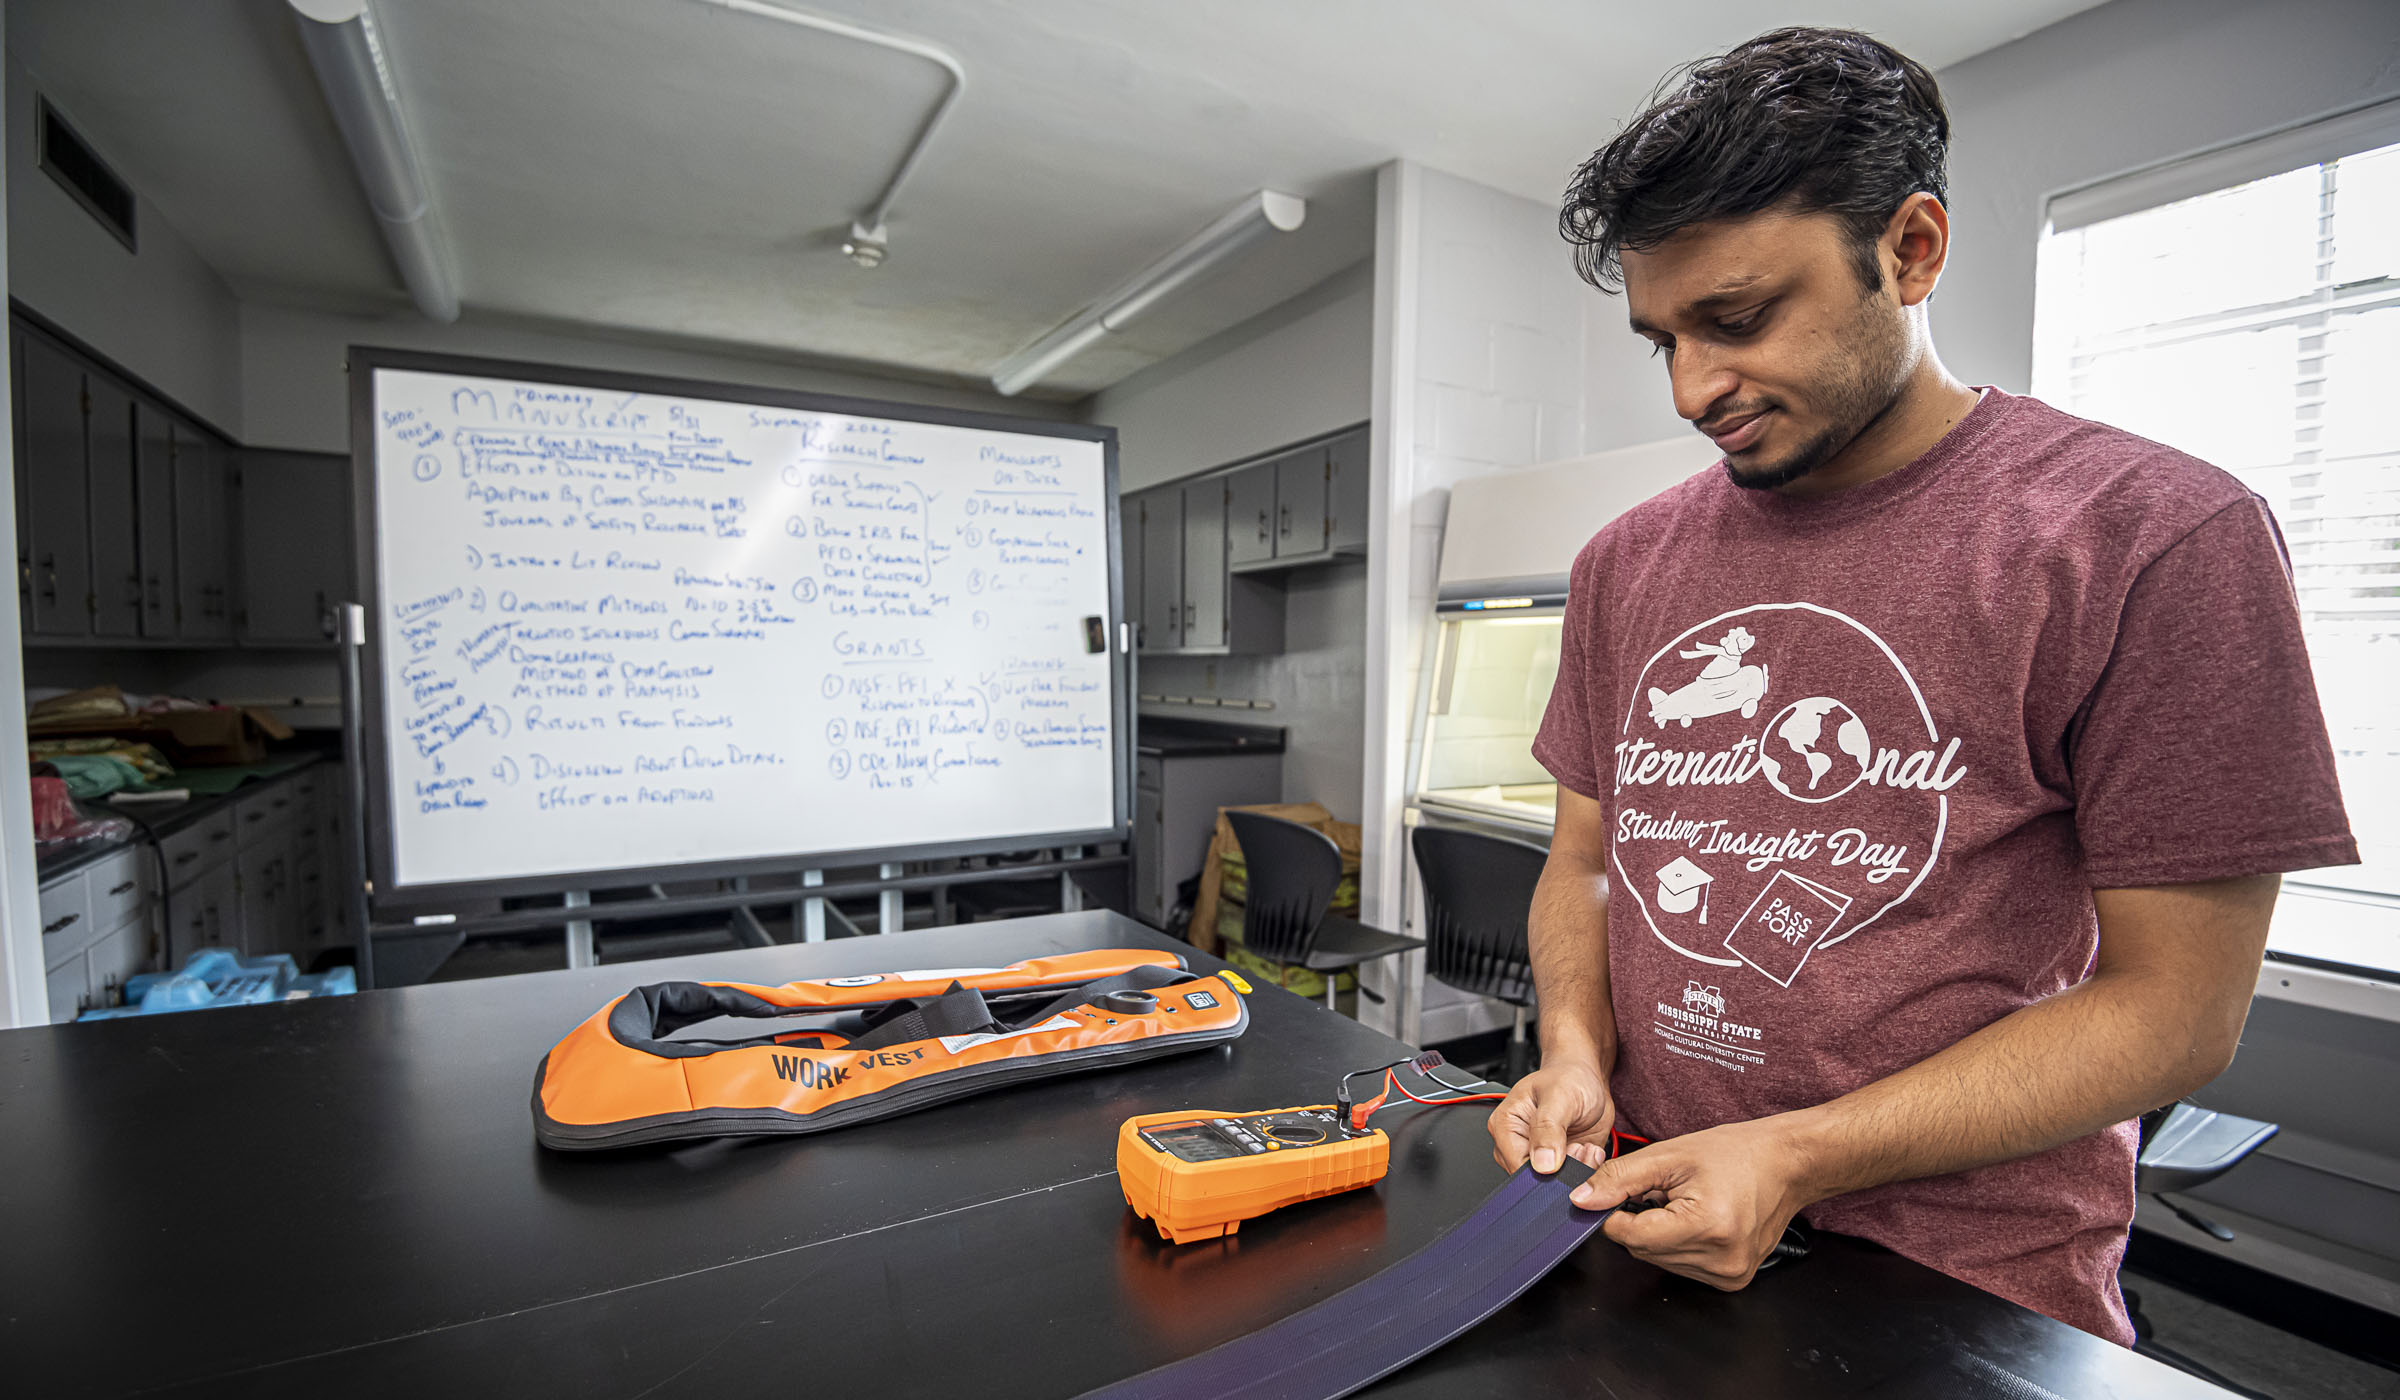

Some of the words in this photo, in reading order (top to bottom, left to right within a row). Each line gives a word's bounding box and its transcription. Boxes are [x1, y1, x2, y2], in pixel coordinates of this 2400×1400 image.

[452, 387, 648, 431] MANUSCRIPT
[833, 630, 925, 656] GRANTS
[848, 677, 880, 696] NSF
[1617, 808, 1705, 848] Student
[1700, 819, 1826, 872] Insight
[1826, 828, 1910, 883] Day
[1758, 912, 1806, 946] PORT
[1768, 897, 1813, 932] PASS
[1689, 991, 1717, 1005] STATE
[1657, 1001, 1718, 1031] MISSISSIPPI
[1722, 1021, 1762, 1040] STATE
[1654, 1027, 1674, 1041] HOLMES
[1674, 1035, 1705, 1049] CULTURAL
[1705, 1043, 1736, 1058] DIVERSITY
[1736, 1053, 1765, 1065] CENTER
[1665, 1043, 1715, 1063] INTERNATIONAL
[1715, 1058, 1745, 1073] INSTITUTE
[772, 1054, 852, 1090] WORK
[859, 1047, 926, 1070] VEST
